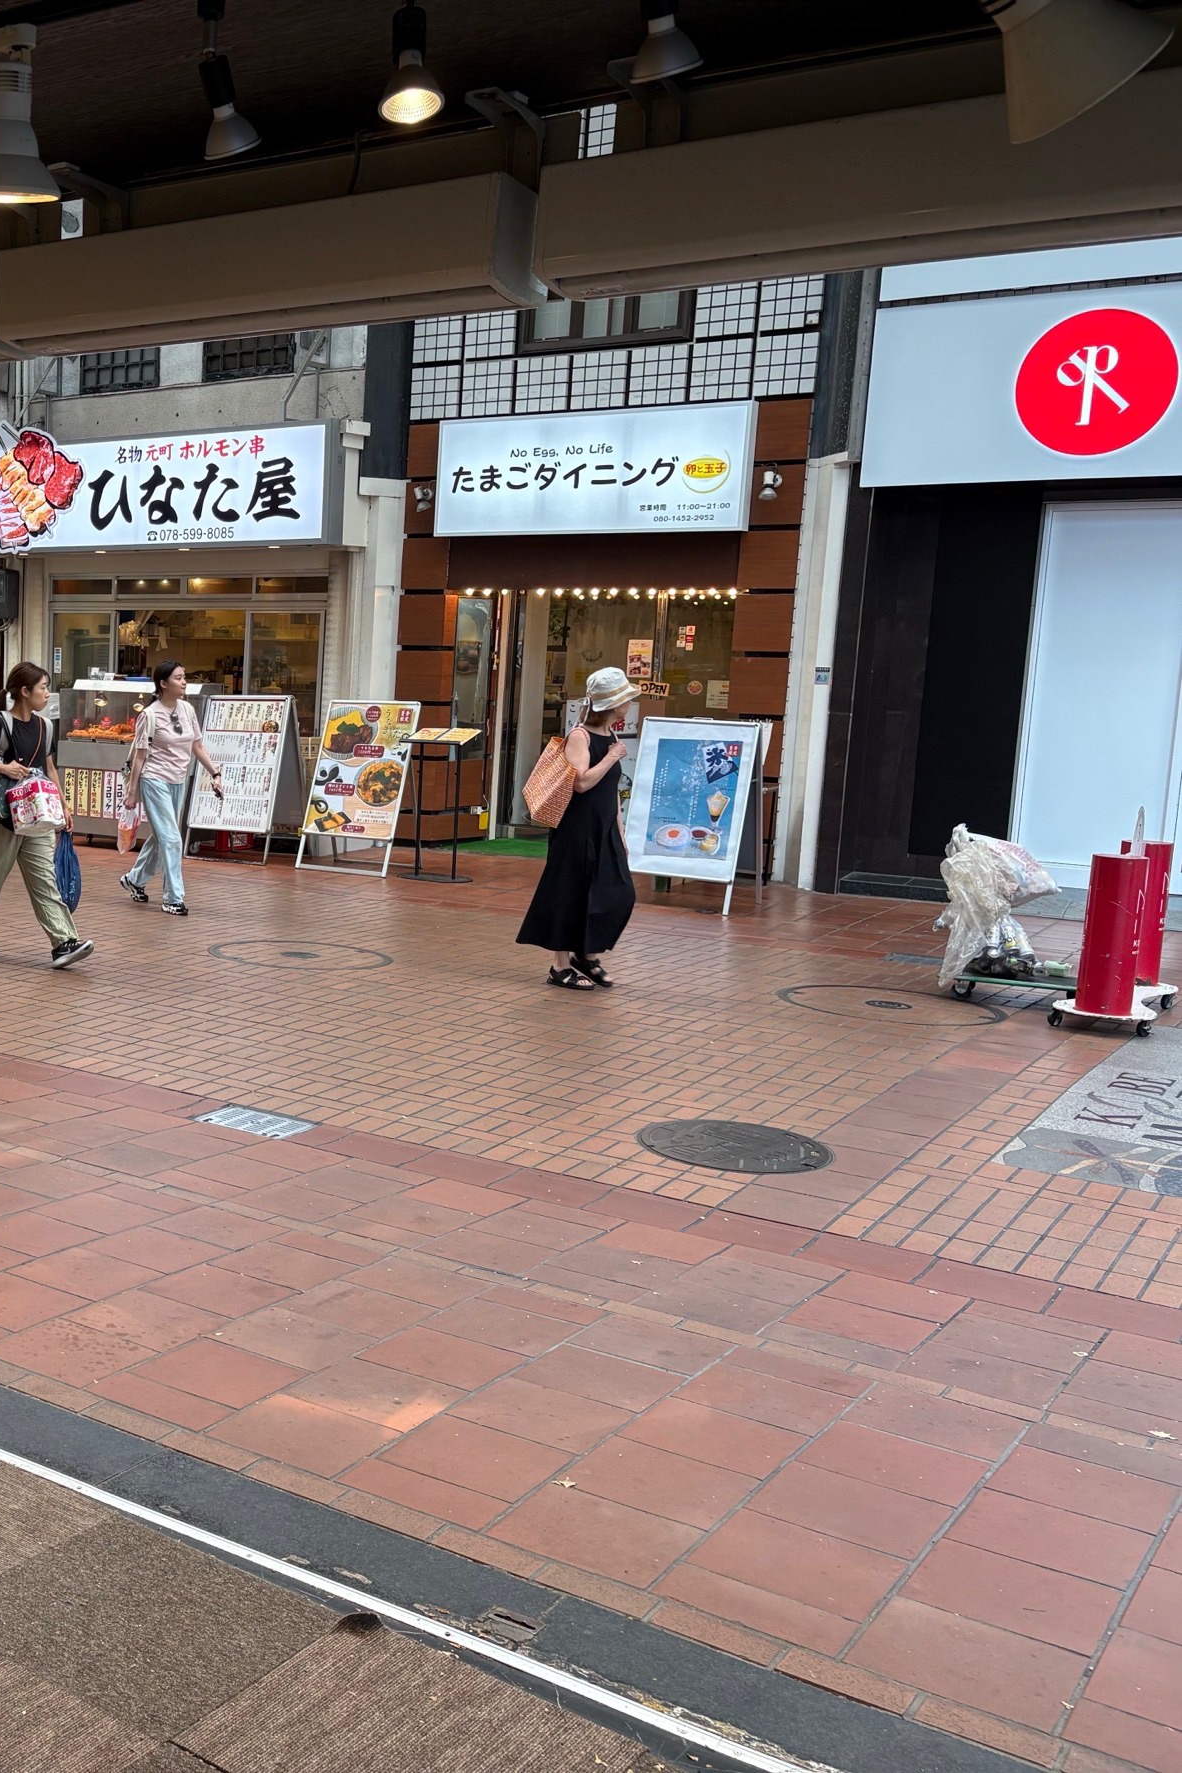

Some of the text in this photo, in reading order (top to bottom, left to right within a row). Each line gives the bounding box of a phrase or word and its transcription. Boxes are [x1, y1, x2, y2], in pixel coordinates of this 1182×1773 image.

[114, 434, 266, 464] 名物 元町 ホルモン串
[510, 443, 613, 459] No Egg, No Life
[451, 455, 680, 494] たまごダイニング
[685, 462, 727, 475] 卵と玉子
[88, 456, 301, 531] ひなた屋
[159, 527, 235, 541] 078-599-8085
[640, 683, 668, 695] OPEN
[705, 747, 729, 768] 氷
